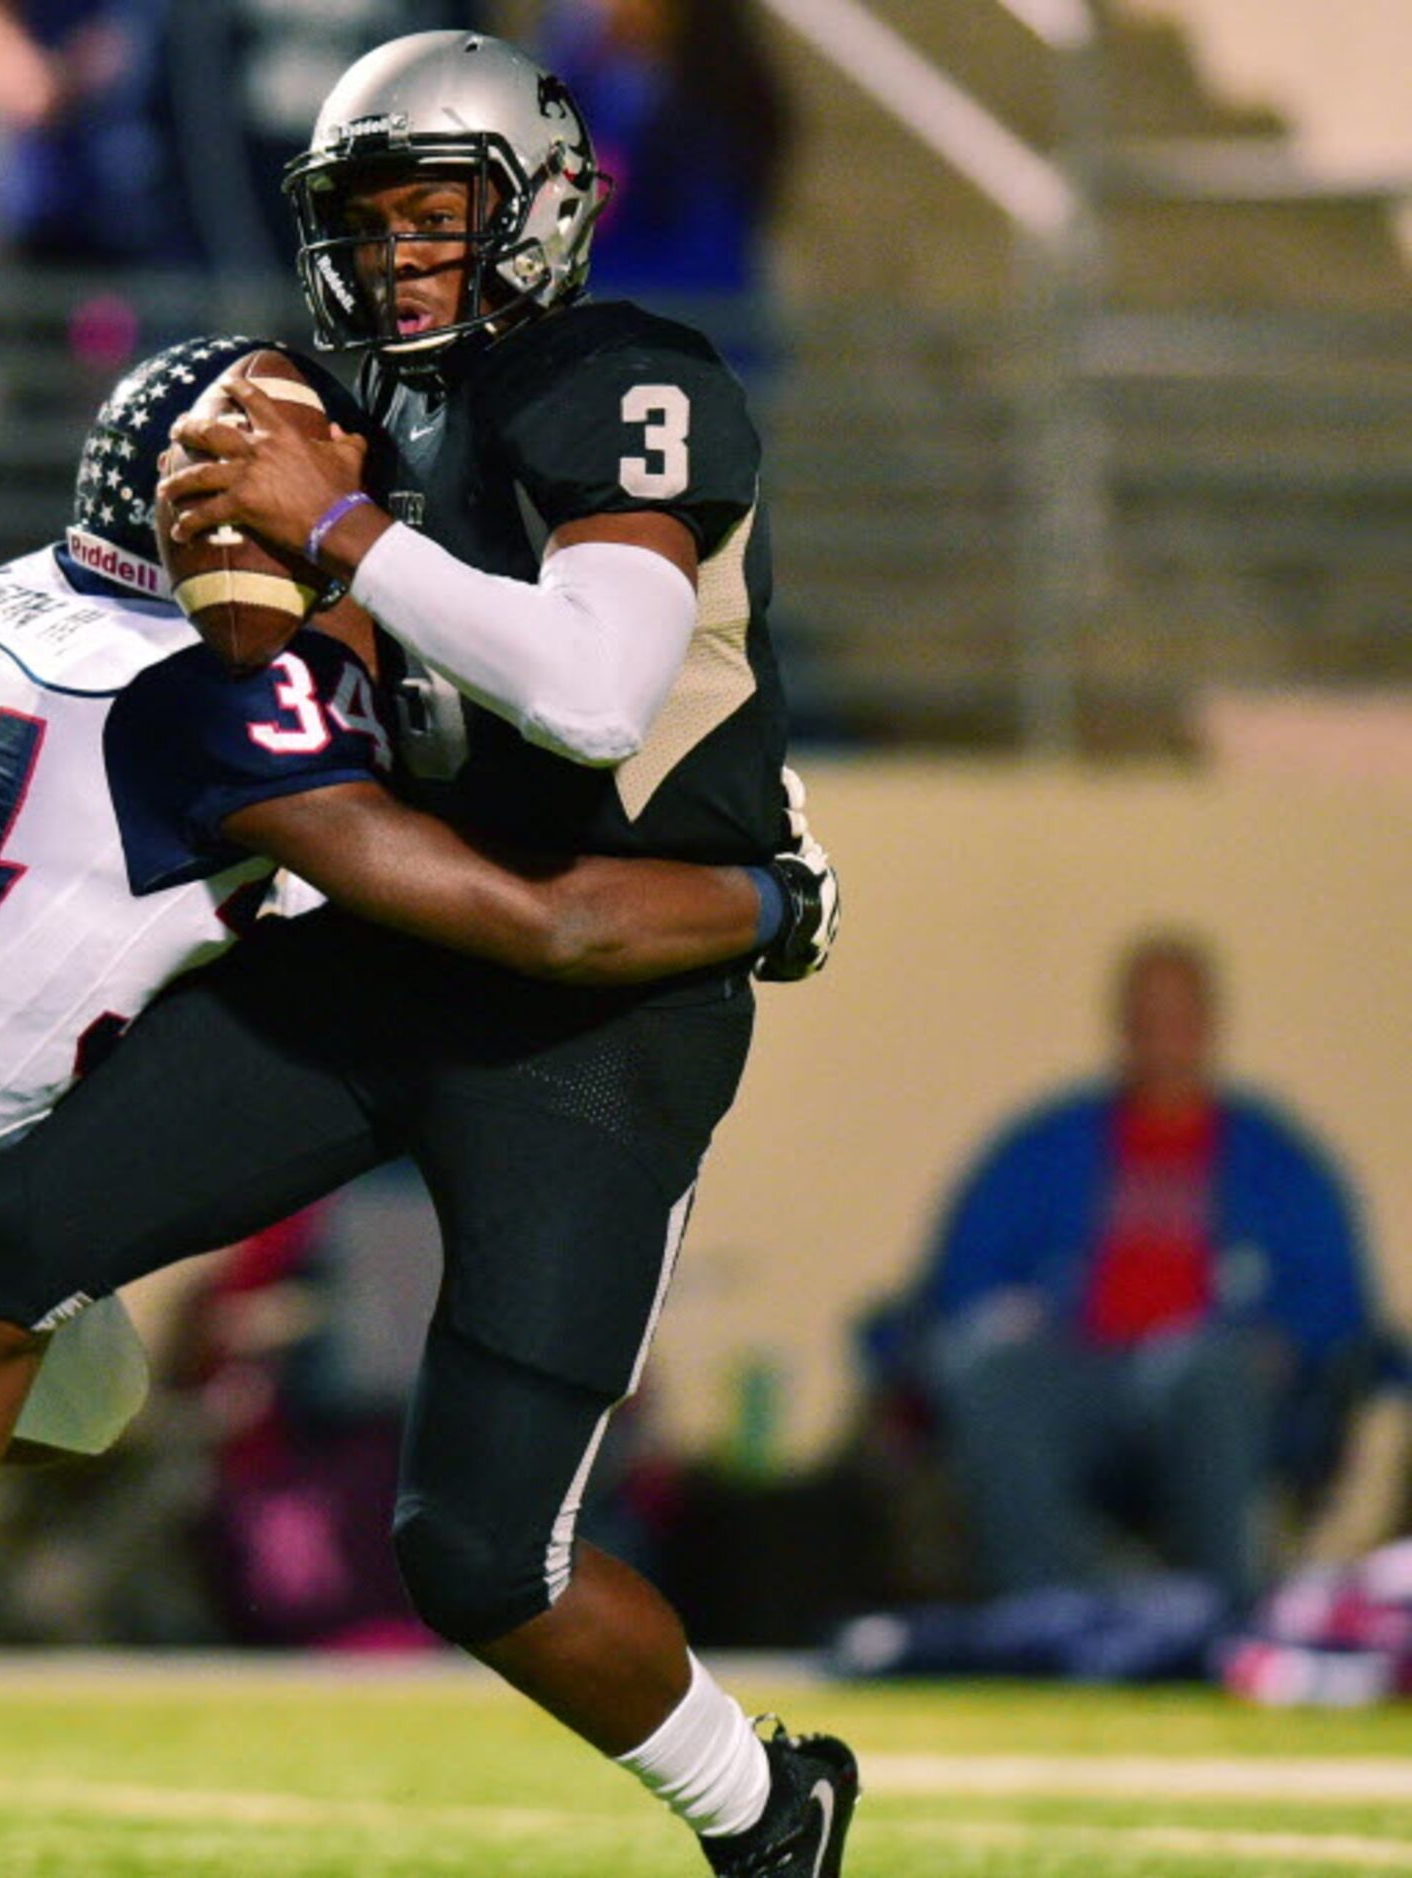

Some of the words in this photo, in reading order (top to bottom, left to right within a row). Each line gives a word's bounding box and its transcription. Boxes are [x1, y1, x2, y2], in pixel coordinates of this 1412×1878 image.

[620, 384, 690, 499] 3
[71, 534, 158, 593] Riddell
[246, 650, 393, 773] 34
